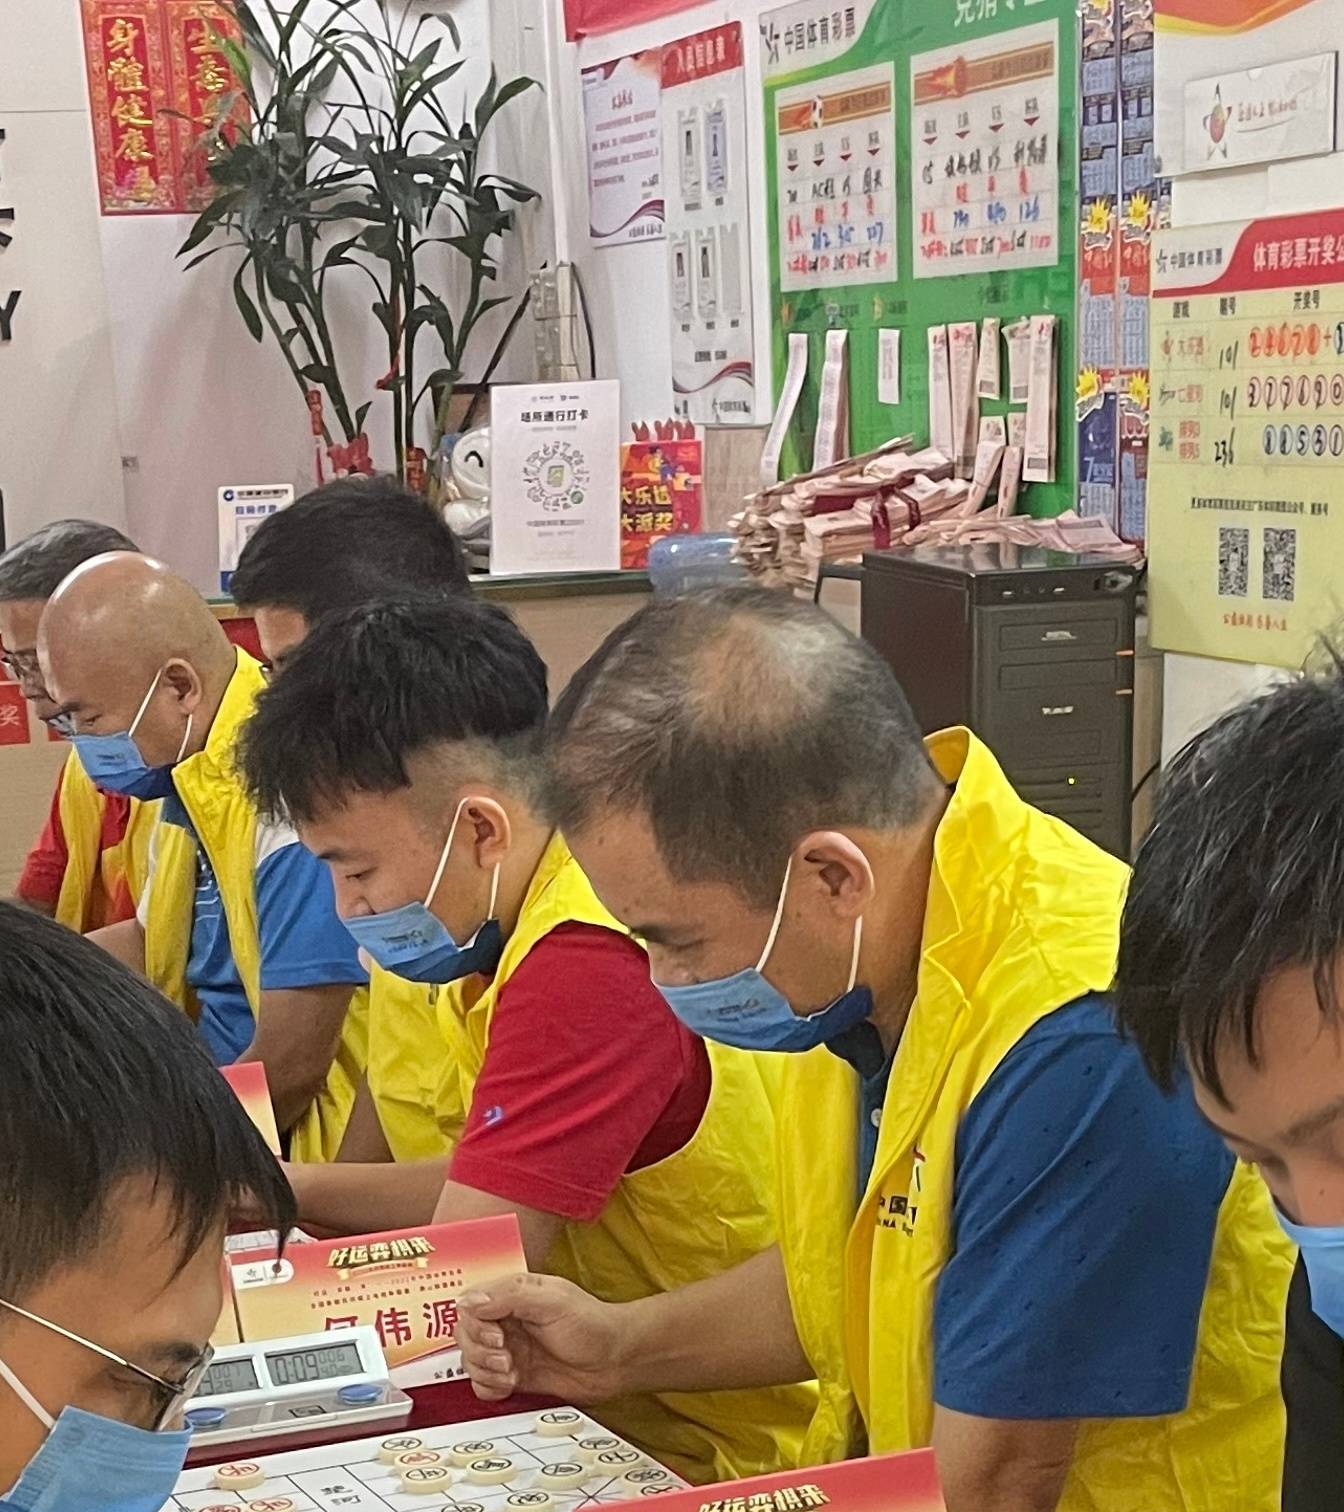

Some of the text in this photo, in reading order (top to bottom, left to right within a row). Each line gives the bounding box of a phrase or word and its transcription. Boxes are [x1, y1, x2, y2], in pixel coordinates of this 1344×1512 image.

[784, 8, 857, 56] 中国体育彩票
[1169, 247, 1223, 270] 中国体育彩票
[1292, 289, 1321, 311] 开奖号
